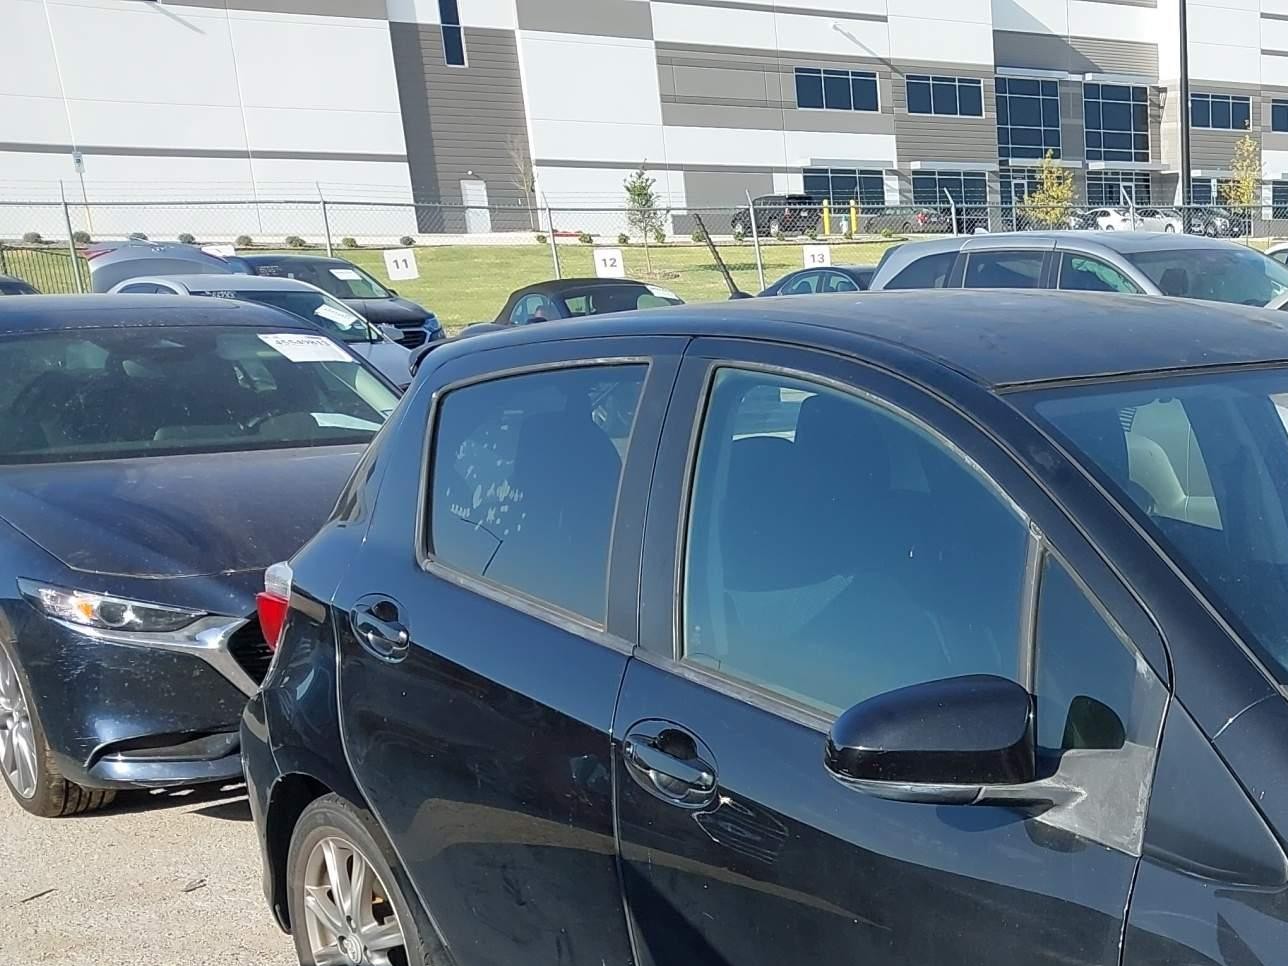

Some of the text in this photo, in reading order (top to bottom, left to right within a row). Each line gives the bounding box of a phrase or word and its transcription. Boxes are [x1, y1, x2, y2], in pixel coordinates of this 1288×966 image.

[392, 258, 409, 270] 11
[601, 257, 617, 268] 12
[810, 253, 825, 264] 13
